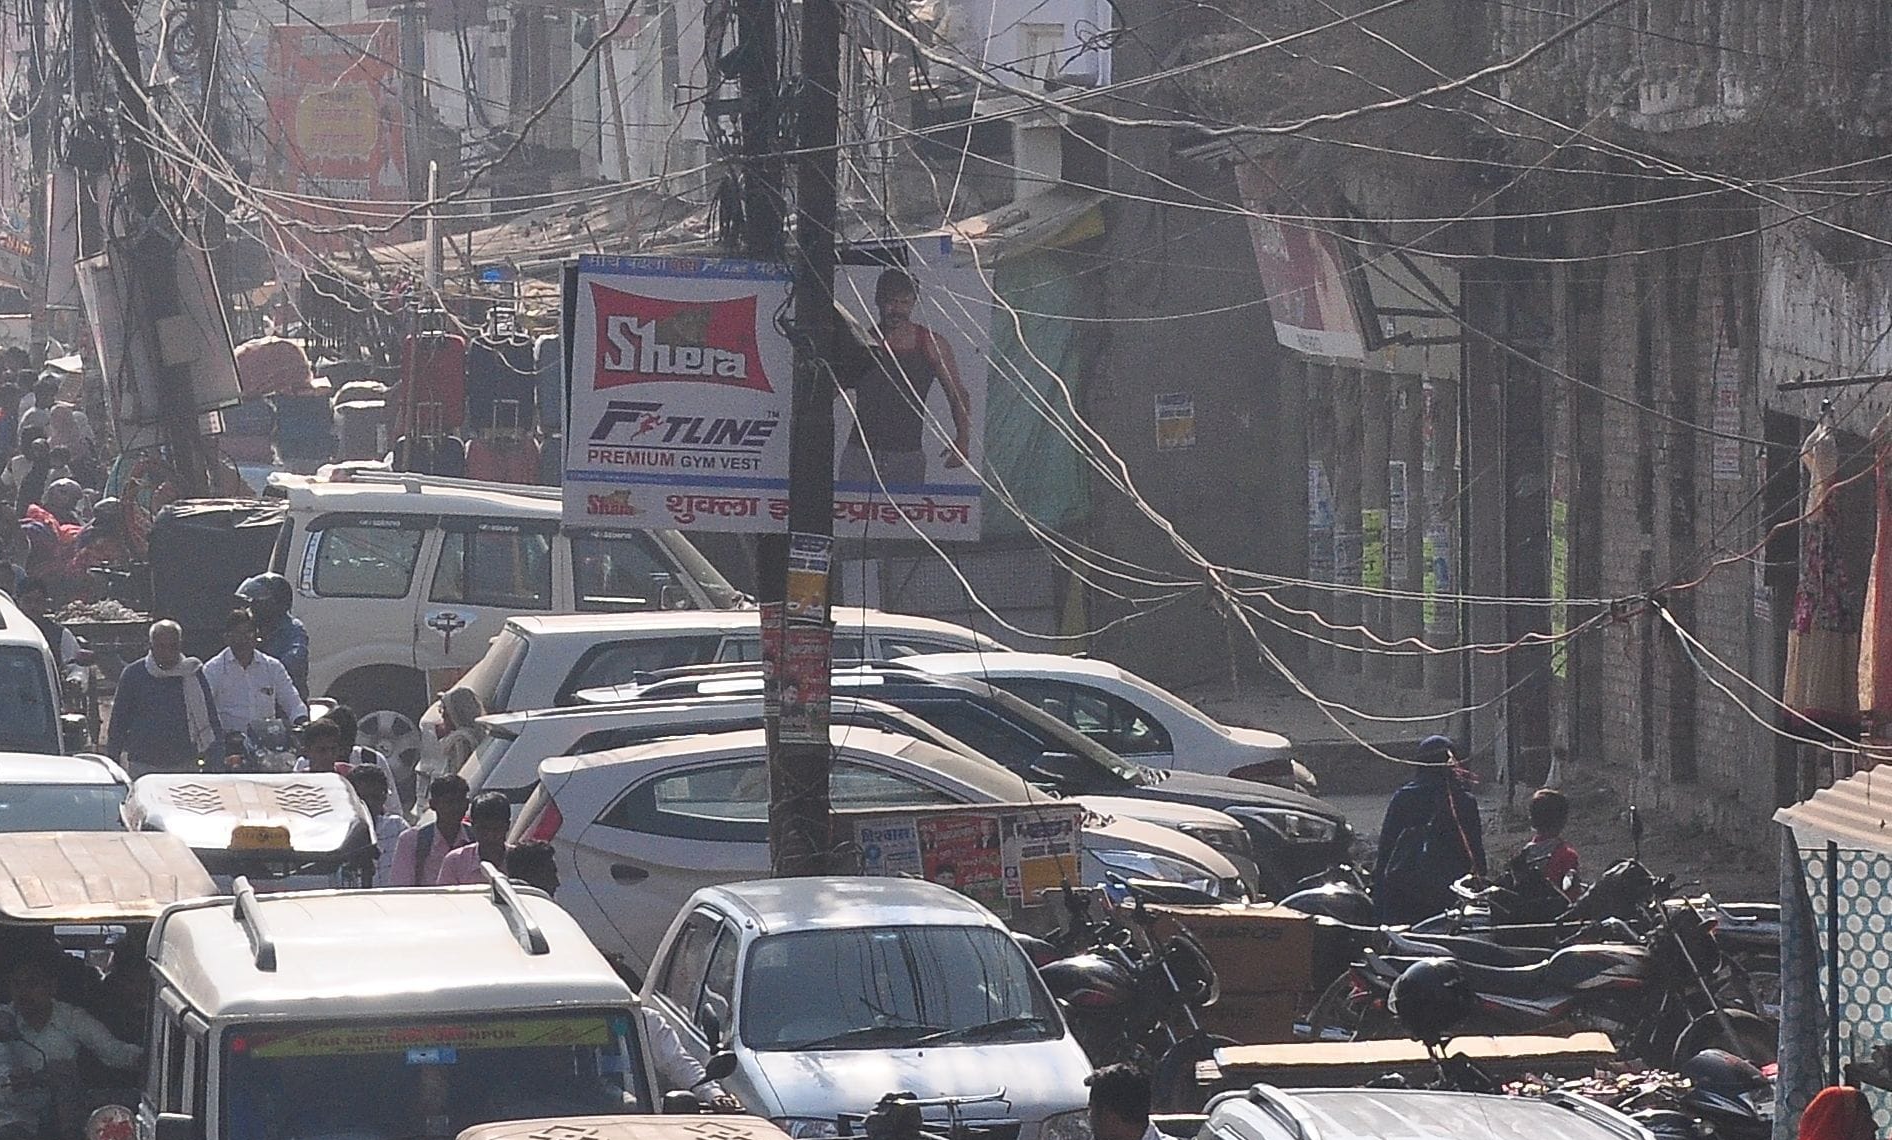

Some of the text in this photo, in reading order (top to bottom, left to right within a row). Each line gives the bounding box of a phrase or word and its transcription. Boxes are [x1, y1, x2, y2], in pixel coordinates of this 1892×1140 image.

[605, 314, 747, 380] Shera
[587, 449, 761, 471] PREMIUM GYM VEST
